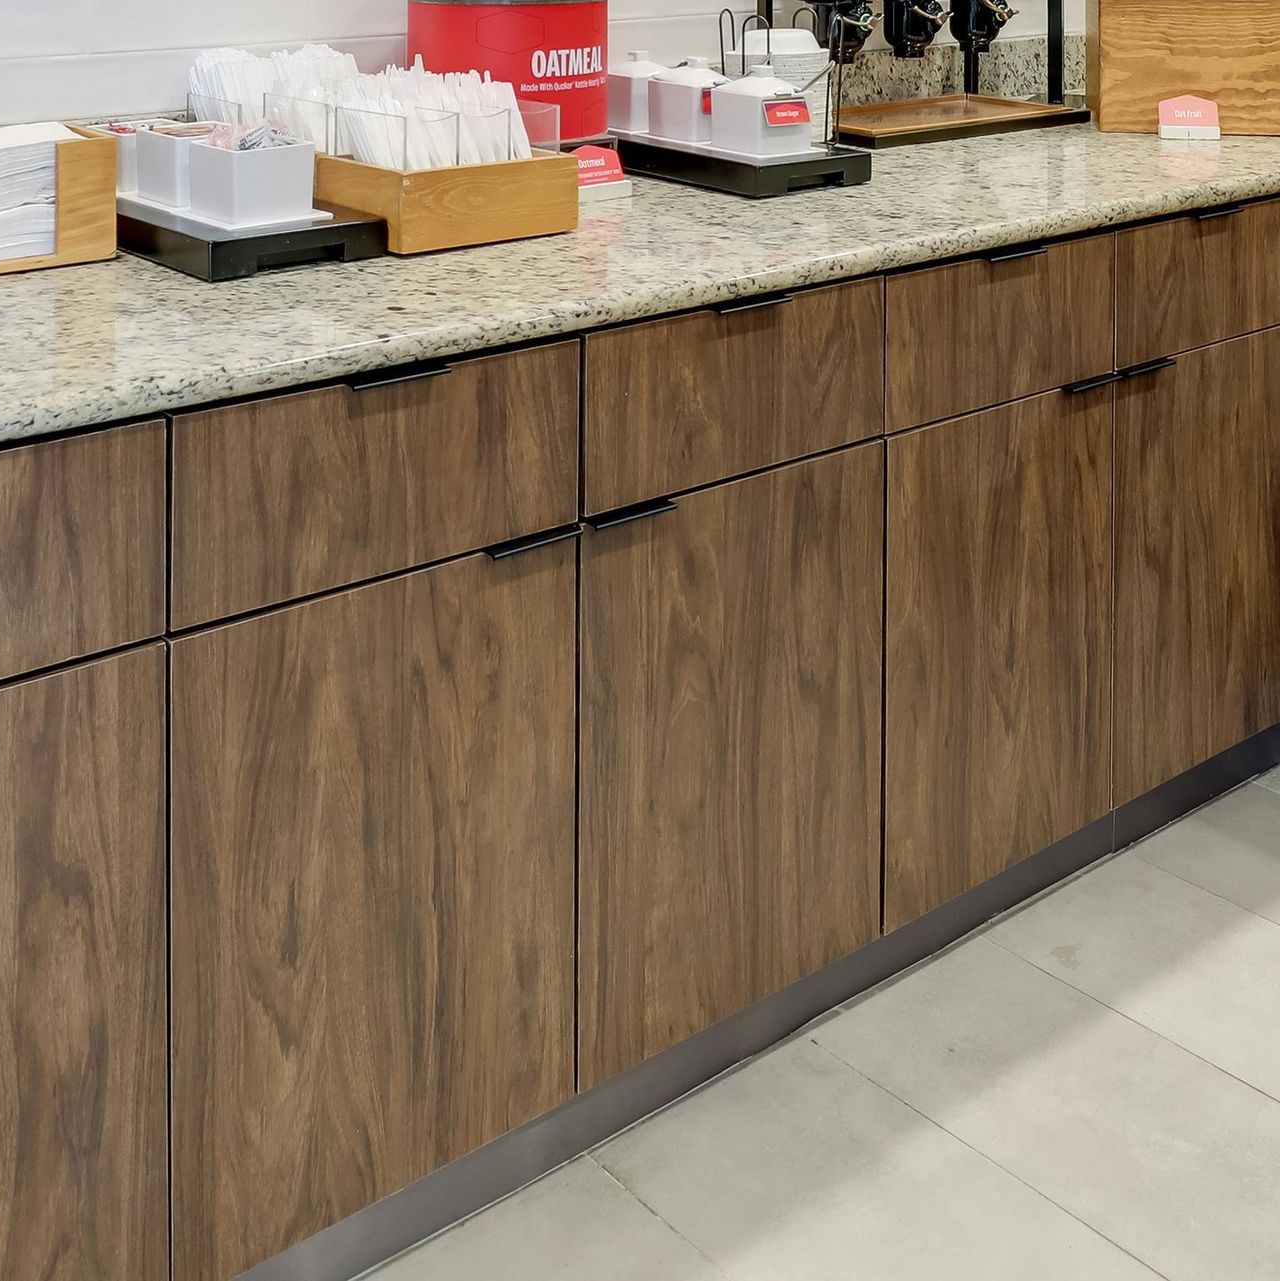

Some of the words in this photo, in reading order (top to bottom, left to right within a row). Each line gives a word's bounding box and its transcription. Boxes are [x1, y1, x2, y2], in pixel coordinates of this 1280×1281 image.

[531, 46, 602, 78] OATMEAL
[520, 83, 539, 92] Made
[539, 82, 553, 91] With
[577, 156, 606, 168] Oatmeal
